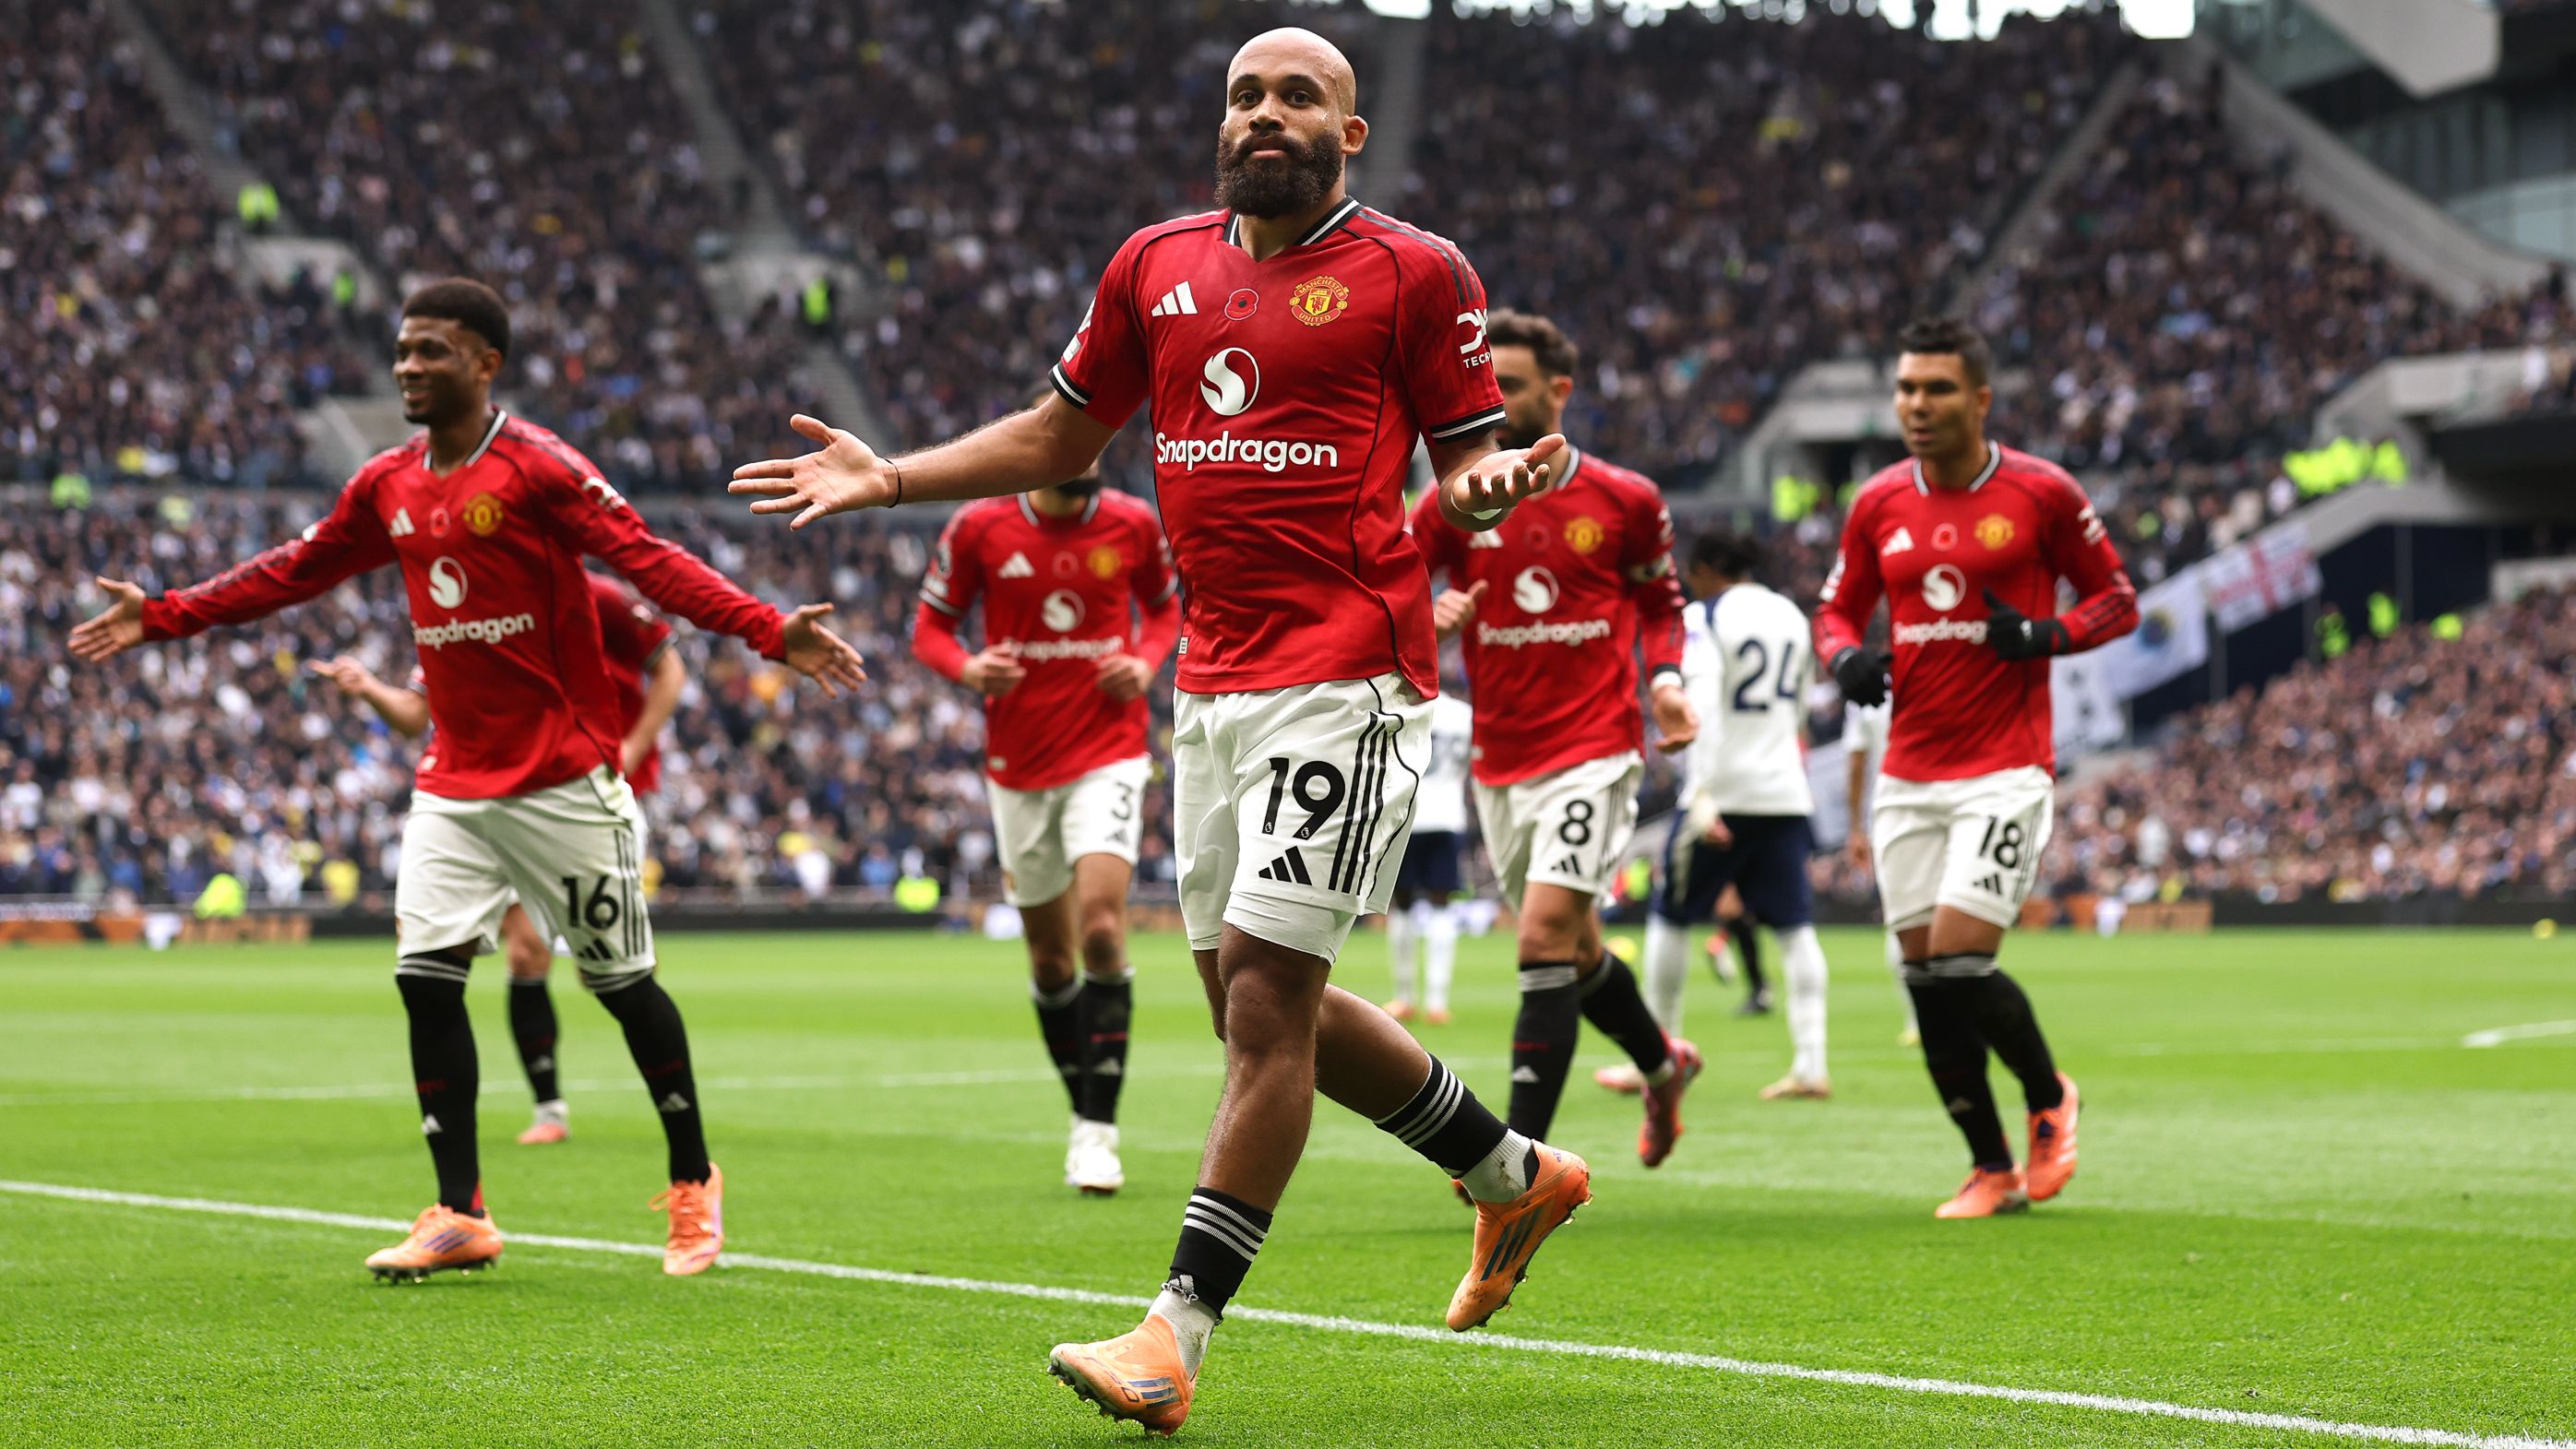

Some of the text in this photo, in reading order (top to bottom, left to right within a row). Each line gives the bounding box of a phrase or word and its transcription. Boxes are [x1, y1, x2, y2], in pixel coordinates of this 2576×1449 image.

[1298, 279, 1344, 298] MANCHESTER
[1298, 312, 1331, 323] UNITED
[1155, 430, 1338, 472] Snapdragon
[411, 612, 535, 651] napdragon
[1477, 618, 1611, 651] Snapdragon
[1111, 780, 1133, 822] 3
[1261, 756, 1346, 841] 19
[1559, 799, 1594, 847] 8
[1978, 814, 2022, 870] 18
[561, 874, 620, 931] 16
